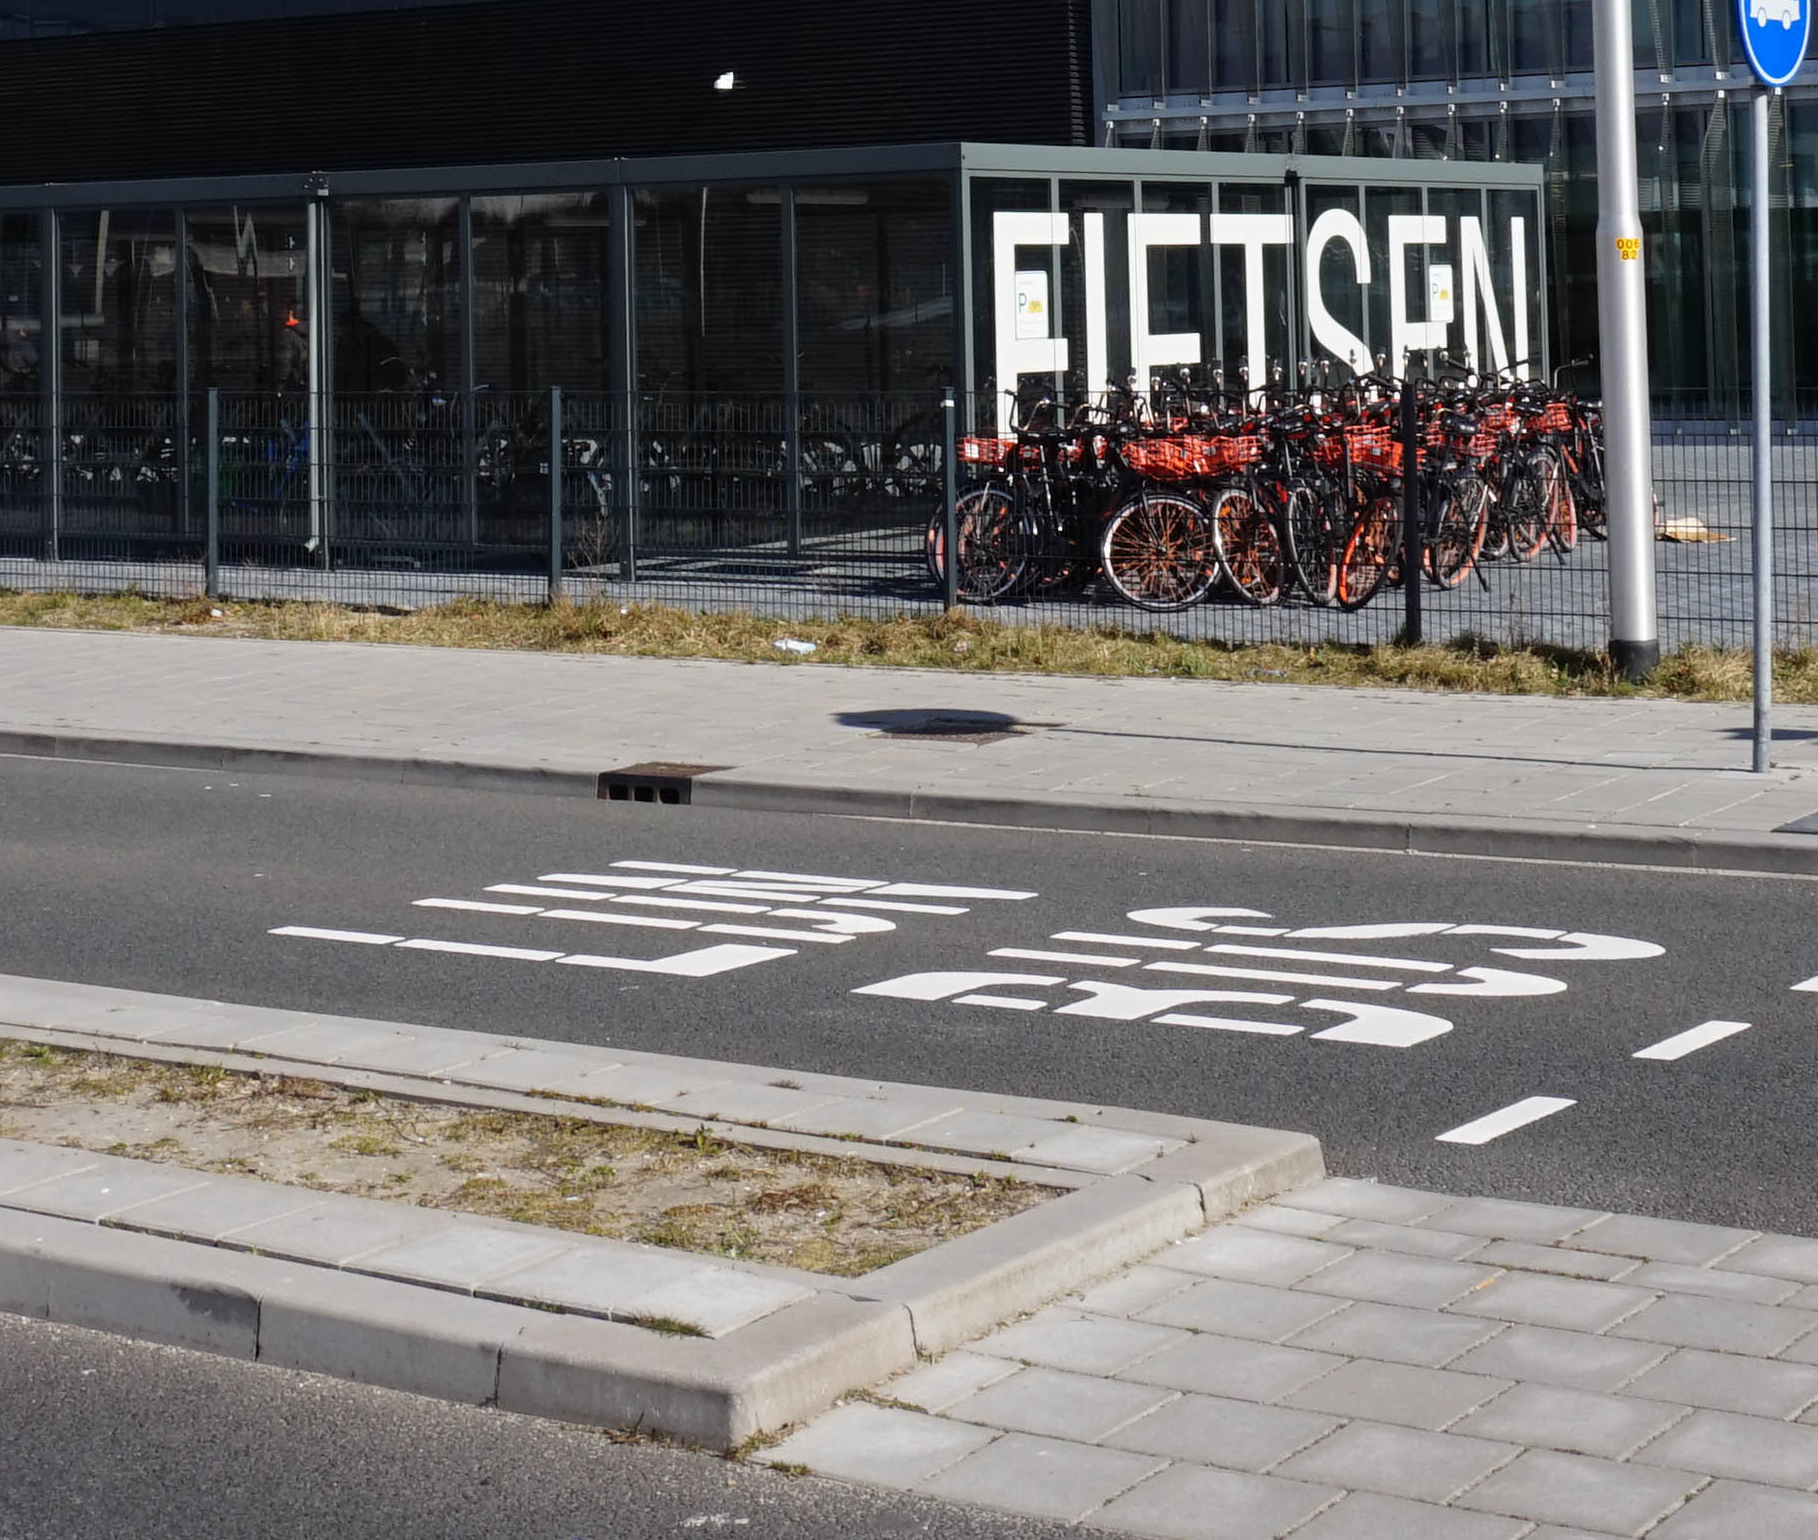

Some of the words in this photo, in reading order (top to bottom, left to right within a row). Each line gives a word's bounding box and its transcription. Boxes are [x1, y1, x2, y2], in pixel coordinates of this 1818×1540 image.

[1622, 250, 1638, 260] 82
[1018, 292, 1028, 314] P
[267, 860, 1039, 978] LIJN
[850, 906, 1666, 1048] BUS
